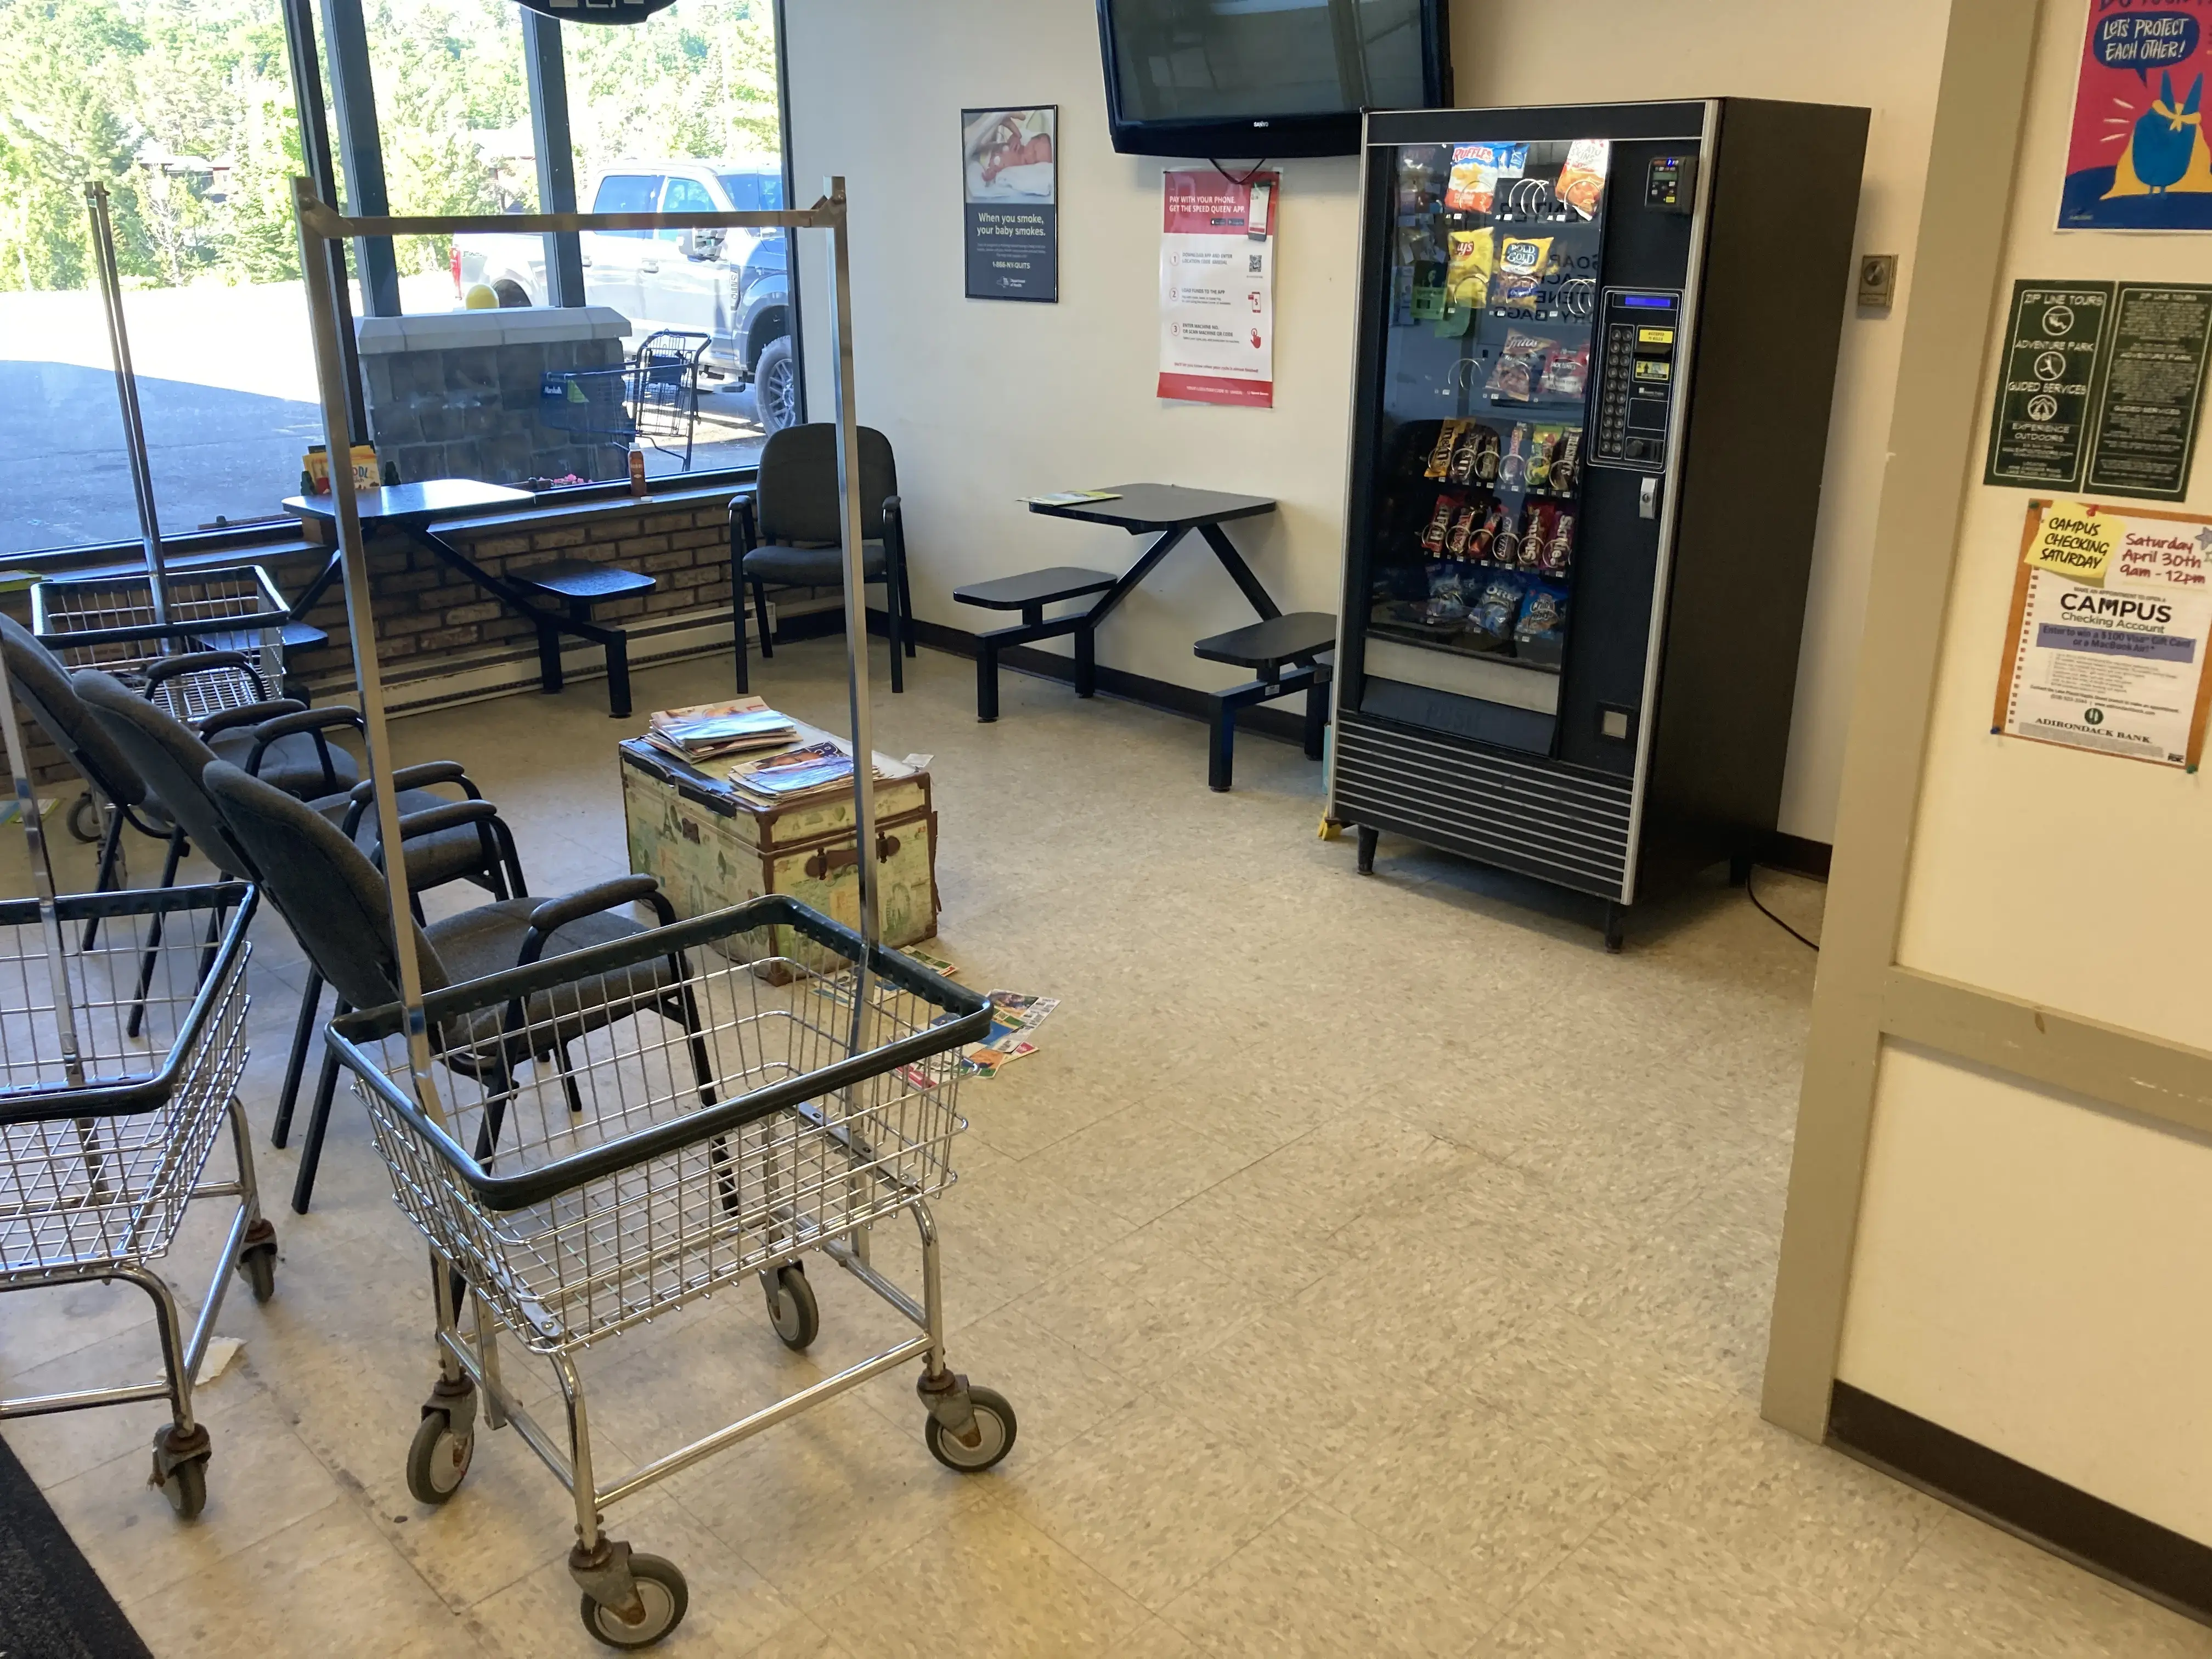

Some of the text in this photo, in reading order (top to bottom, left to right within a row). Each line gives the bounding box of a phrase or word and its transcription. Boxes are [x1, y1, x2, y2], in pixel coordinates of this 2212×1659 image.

[2134, 18, 2189, 38] PROTECT
[2106, 40, 2186, 61] EACH OTHER!
[978, 212, 1045, 225] When you smoke,
[977, 225, 1046, 238] your baby smokes.
[1507, 252, 1535, 265] GOLD
[2024, 294, 2103, 306] ZIP LINE TOURS
[2015, 340, 2095, 352] ADVENTURE PARK
[2008, 381, 2087, 395] GUIDED SERVICES
[2049, 517, 2101, 537] CAMPUS
[2045, 533, 2110, 556] CHECKING
[2125, 533, 2194, 554] Saturday
[2040, 548, 2102, 569] SATURDAY
[2121, 549, 2202, 568] April 30th
[2120, 564, 2151, 578] 9am
[2166, 570, 2205, 585] 12pm
[2061, 593, 2172, 623] CAMPUS
[2043, 625, 2066, 635] Enter
[2101, 631, 2125, 641] $100
[2061, 612, 2166, 634] Checking Account
[2091, 640, 2132, 651] MacBook
[2035, 718, 2113, 737] ADIRONDACK
[2117, 731, 2151, 743] BANK
